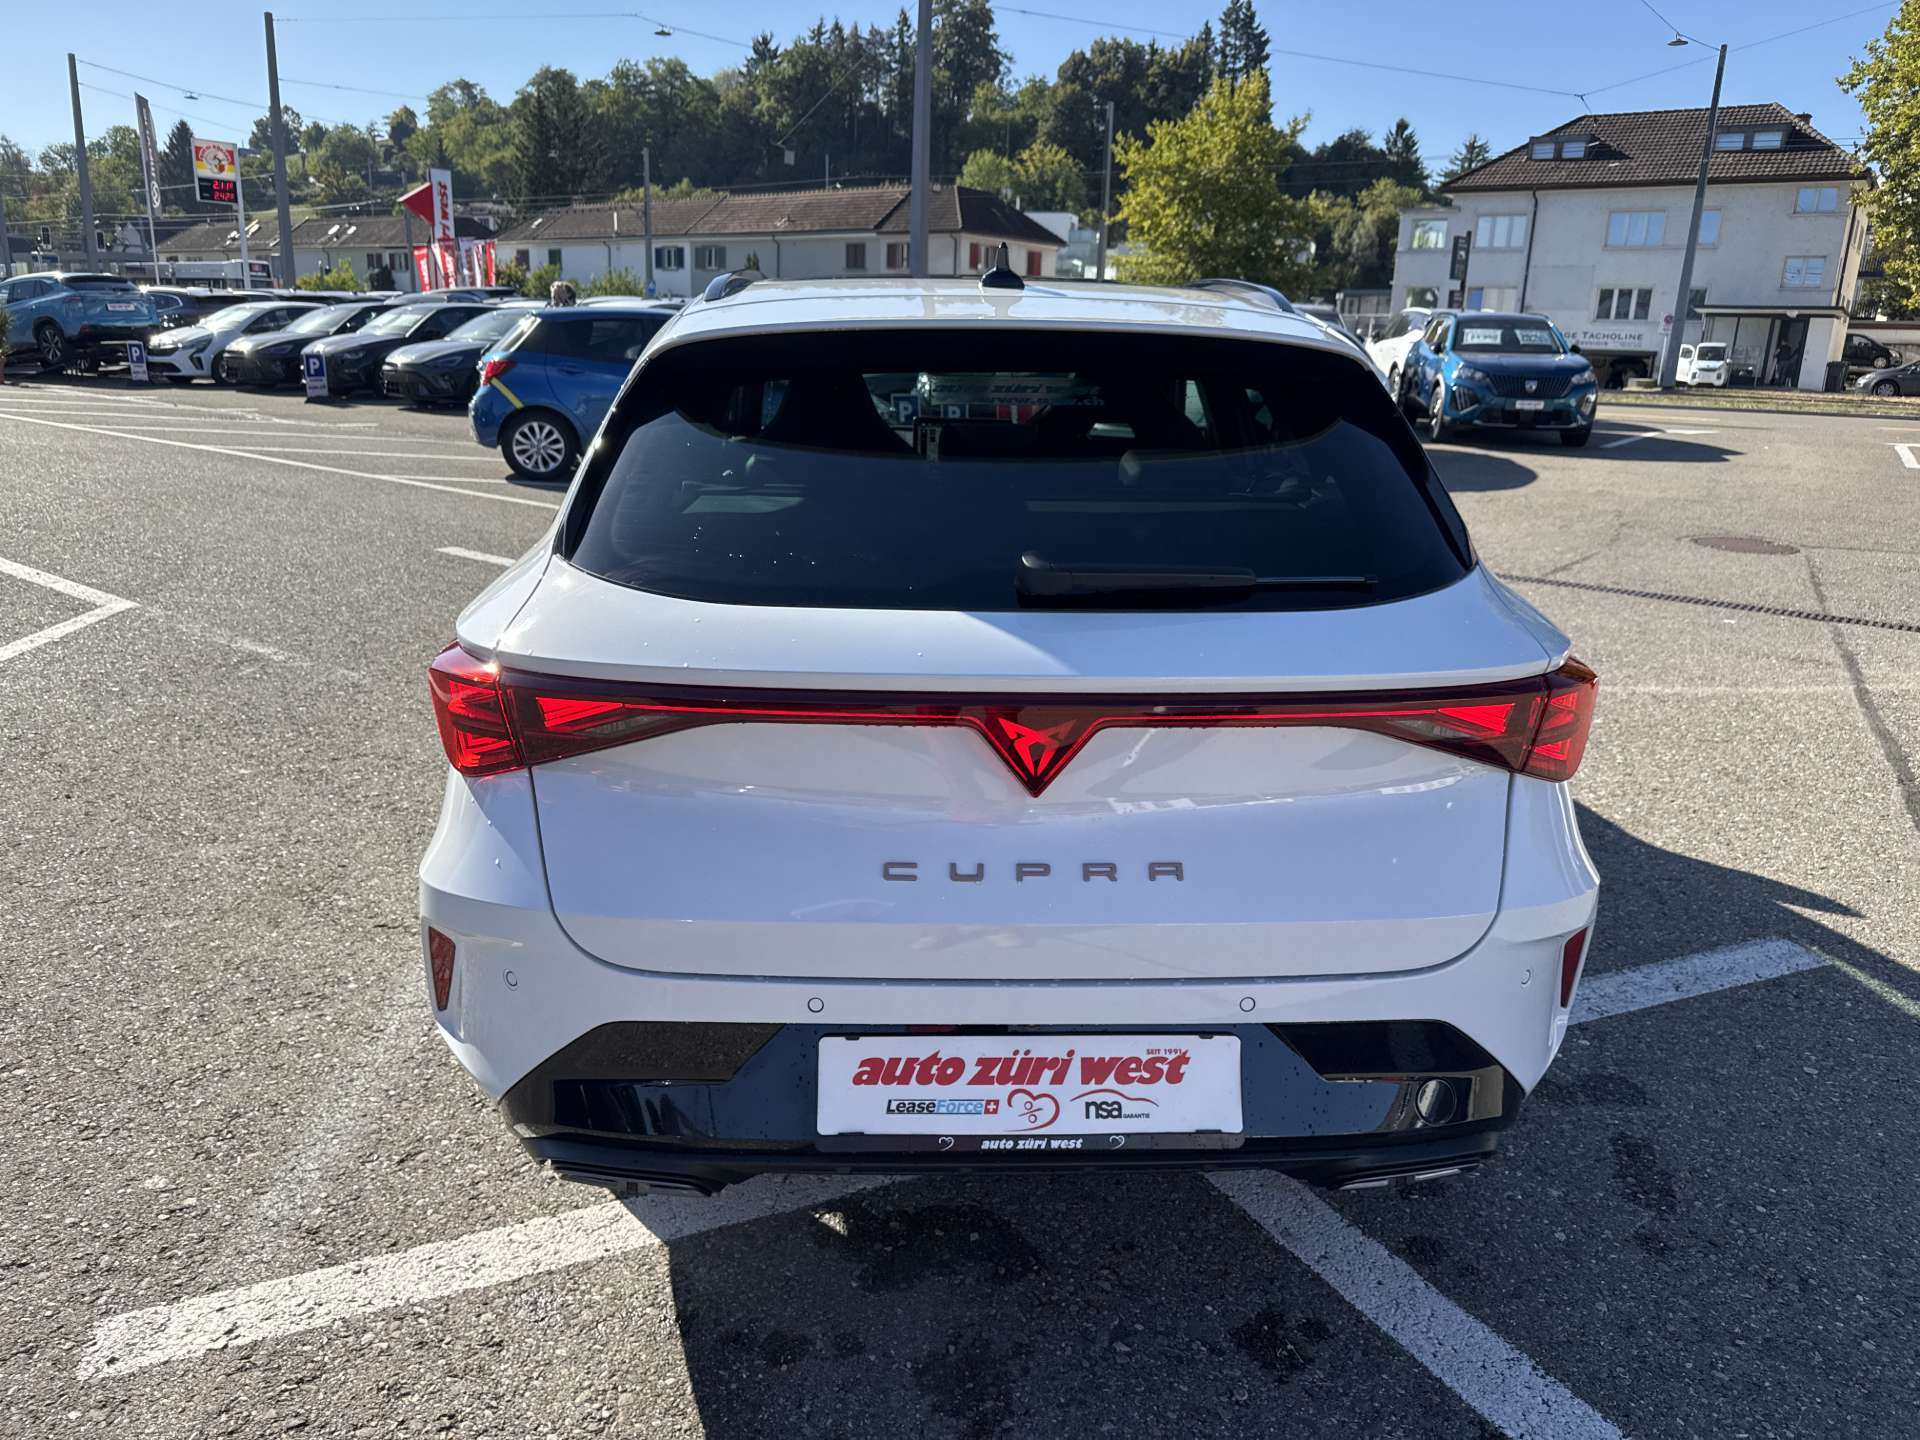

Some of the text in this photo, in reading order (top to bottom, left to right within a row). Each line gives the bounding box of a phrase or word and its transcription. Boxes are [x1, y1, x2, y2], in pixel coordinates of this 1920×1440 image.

[1583, 331, 1644, 341] TACHOLINE
[131, 346, 140, 361] P
[309, 358, 320, 375] P
[900, 401, 912, 422] P
[883, 862, 1184, 882] CUPRA
[852, 1049, 1191, 1086] auto züri west
[886, 1099, 984, 1114] LeaseForce
[1085, 1101, 1122, 1119] nsa
[981, 1137, 1084, 1150] auto züri west
